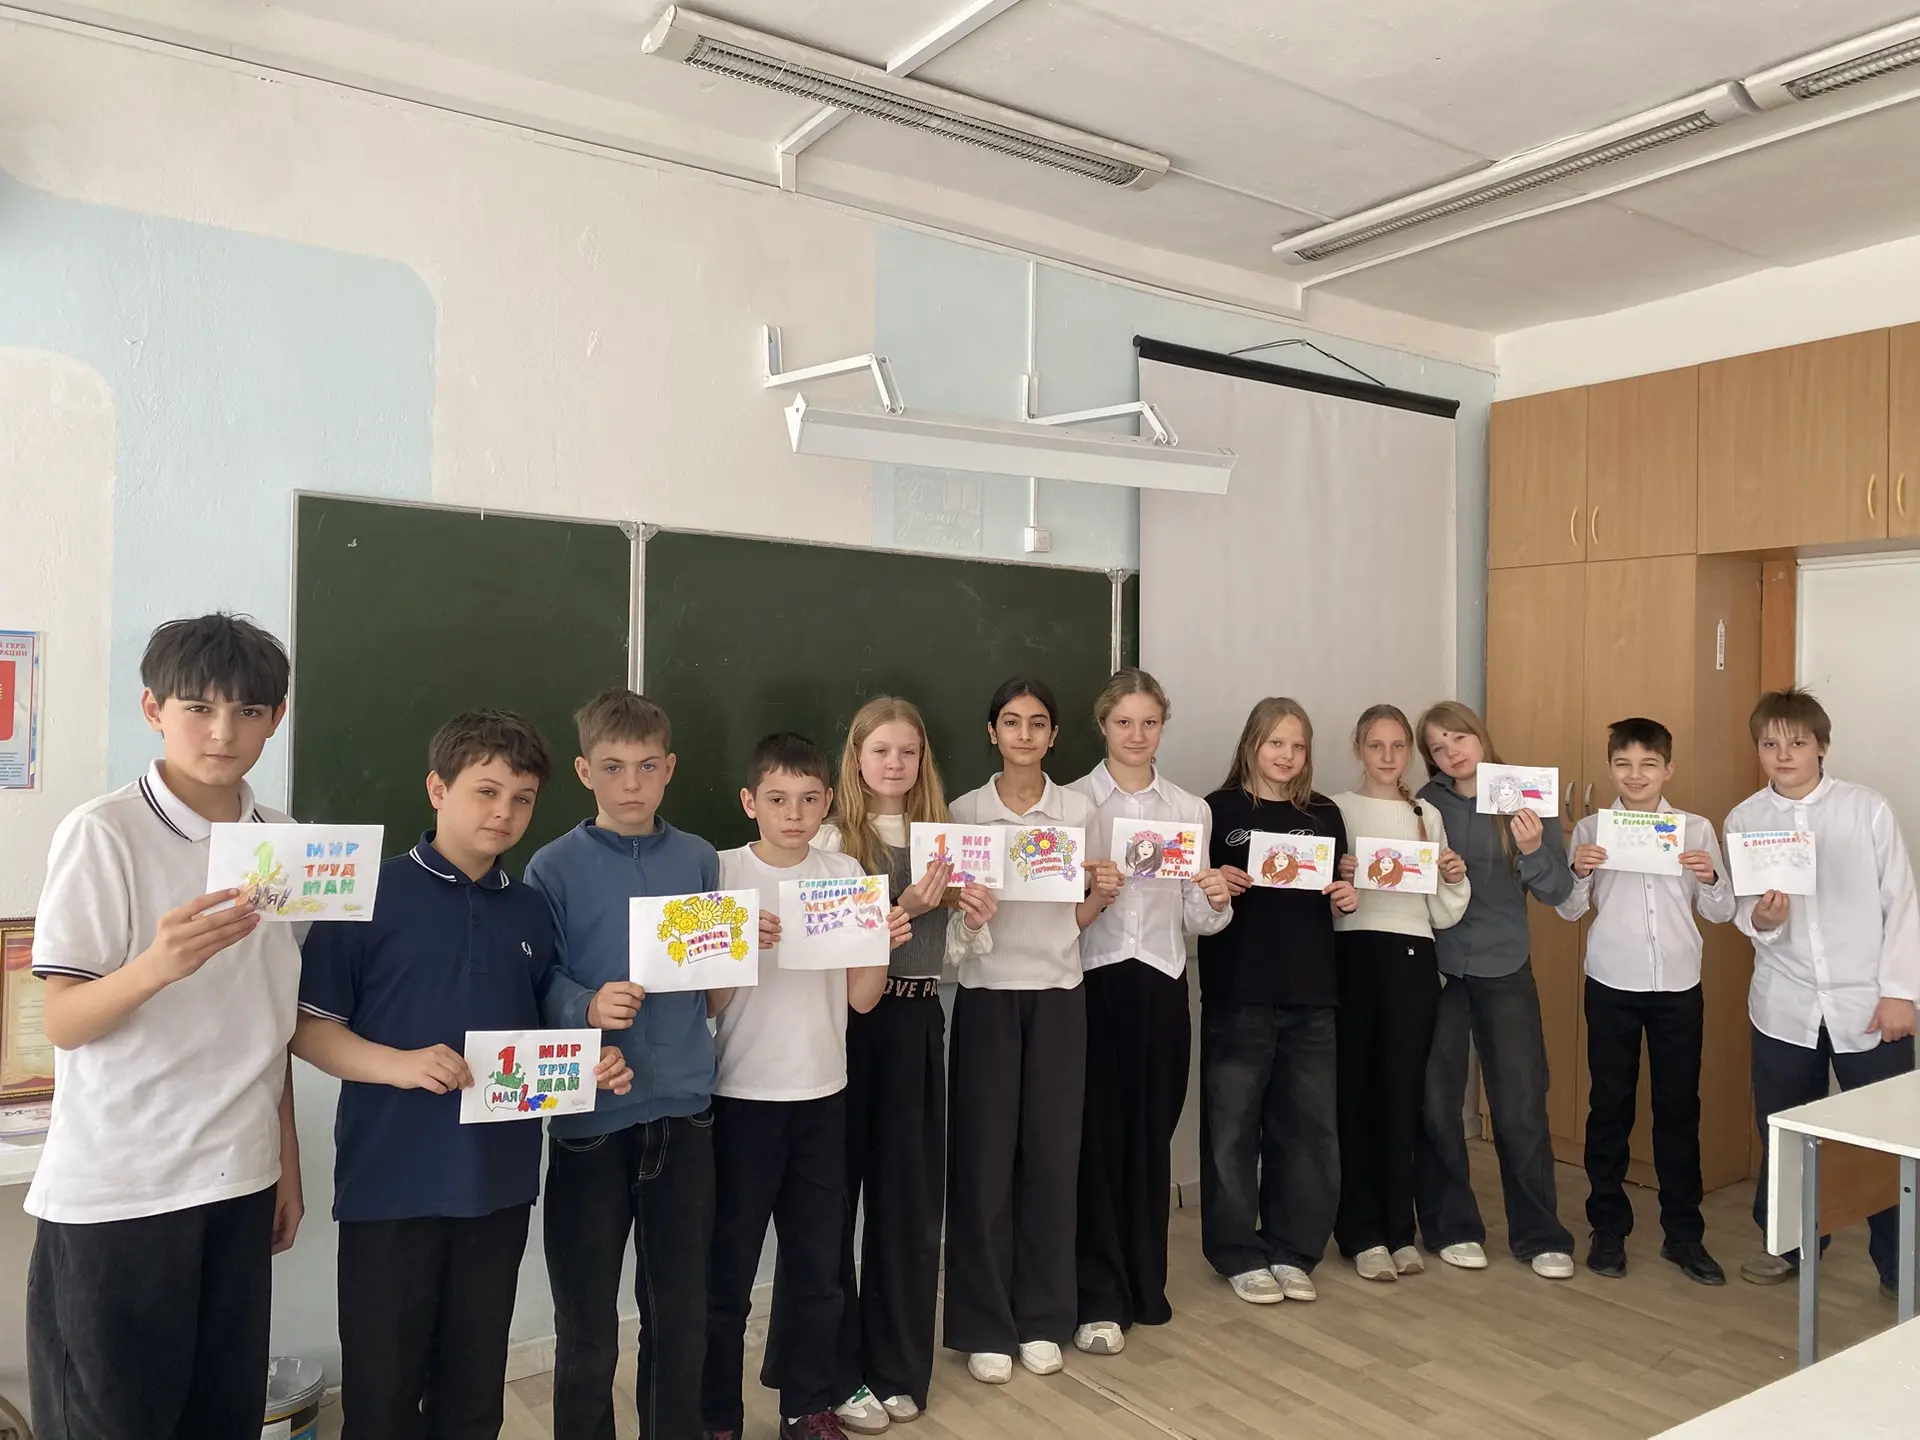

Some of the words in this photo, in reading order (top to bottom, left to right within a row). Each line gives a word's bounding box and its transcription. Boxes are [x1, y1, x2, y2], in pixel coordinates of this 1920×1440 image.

[935, 833, 946, 856] 1
[962, 835, 992, 846] МИР
[306, 841, 360, 858] МИР
[961, 849, 991, 861] ТРУД
[302, 863, 356, 878] ТРУД
[804, 908, 852, 924] ТРУД
[538, 1043, 582, 1059] МИР
[498, 1046, 516, 1077] 1
[537, 1062, 580, 1076] ТРУД
[536, 1075, 580, 1093] МАЙ
